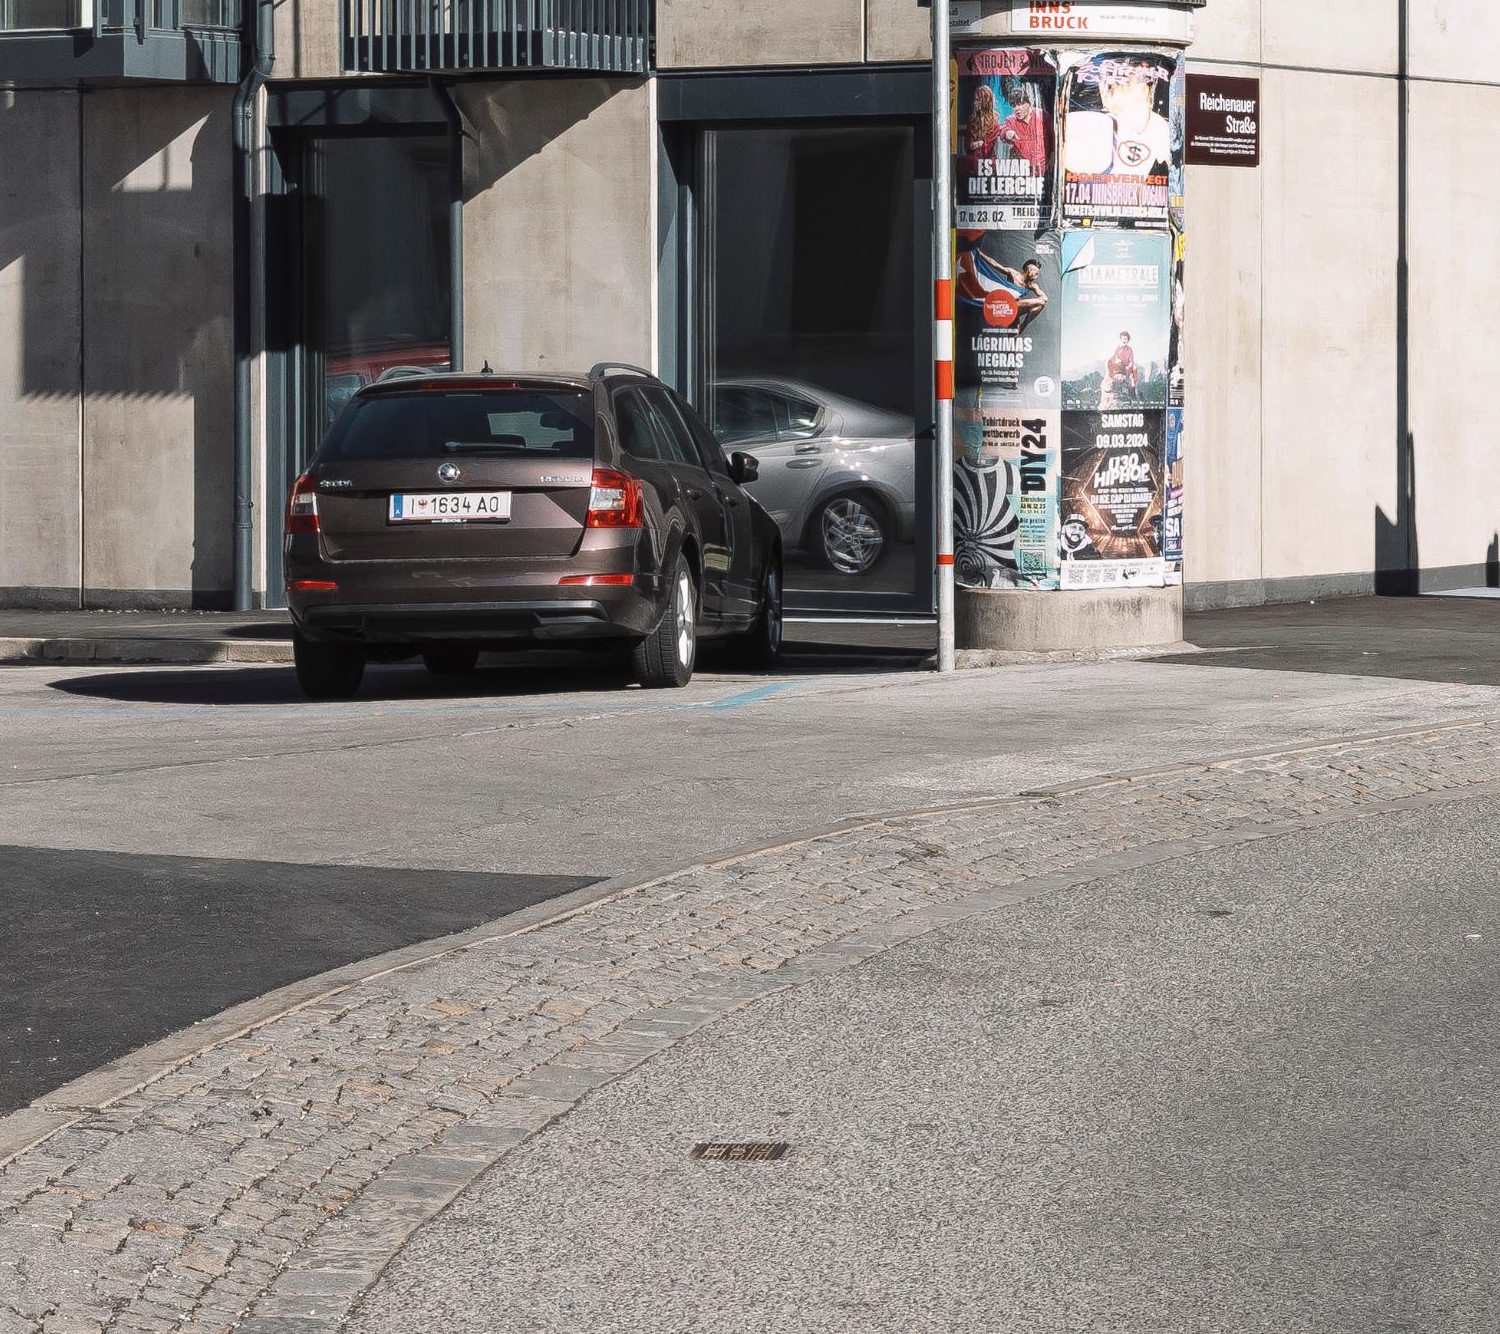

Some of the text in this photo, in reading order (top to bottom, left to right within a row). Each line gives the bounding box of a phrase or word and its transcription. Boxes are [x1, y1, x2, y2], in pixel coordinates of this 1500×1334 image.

[1029, 15, 1089, 29] BRUCK
[1199, 92, 1256, 113] Reichenauer
[1225, 114, 1257, 134] Straße
[977, 158, 1032, 176] ES WAR
[968, 177, 1045, 196] DIE LERCHE
[1065, 183, 1090, 204] 17.04
[977, 211, 990, 222] 23.
[992, 211, 1007, 222] 02.
[1081, 267, 1157, 282] DIAMETRALE
[972, 334, 1033, 352] LÁGRIMAS
[977, 353, 1024, 368] NEGRAS
[1101, 413, 1144, 428] SAMSTAG
[1096, 433, 1148, 448] 09.03.2024
[1020, 418, 1046, 495] DIY24
[1093, 463, 1150, 488] HIPHOP
[431, 497, 471, 514] 1634
